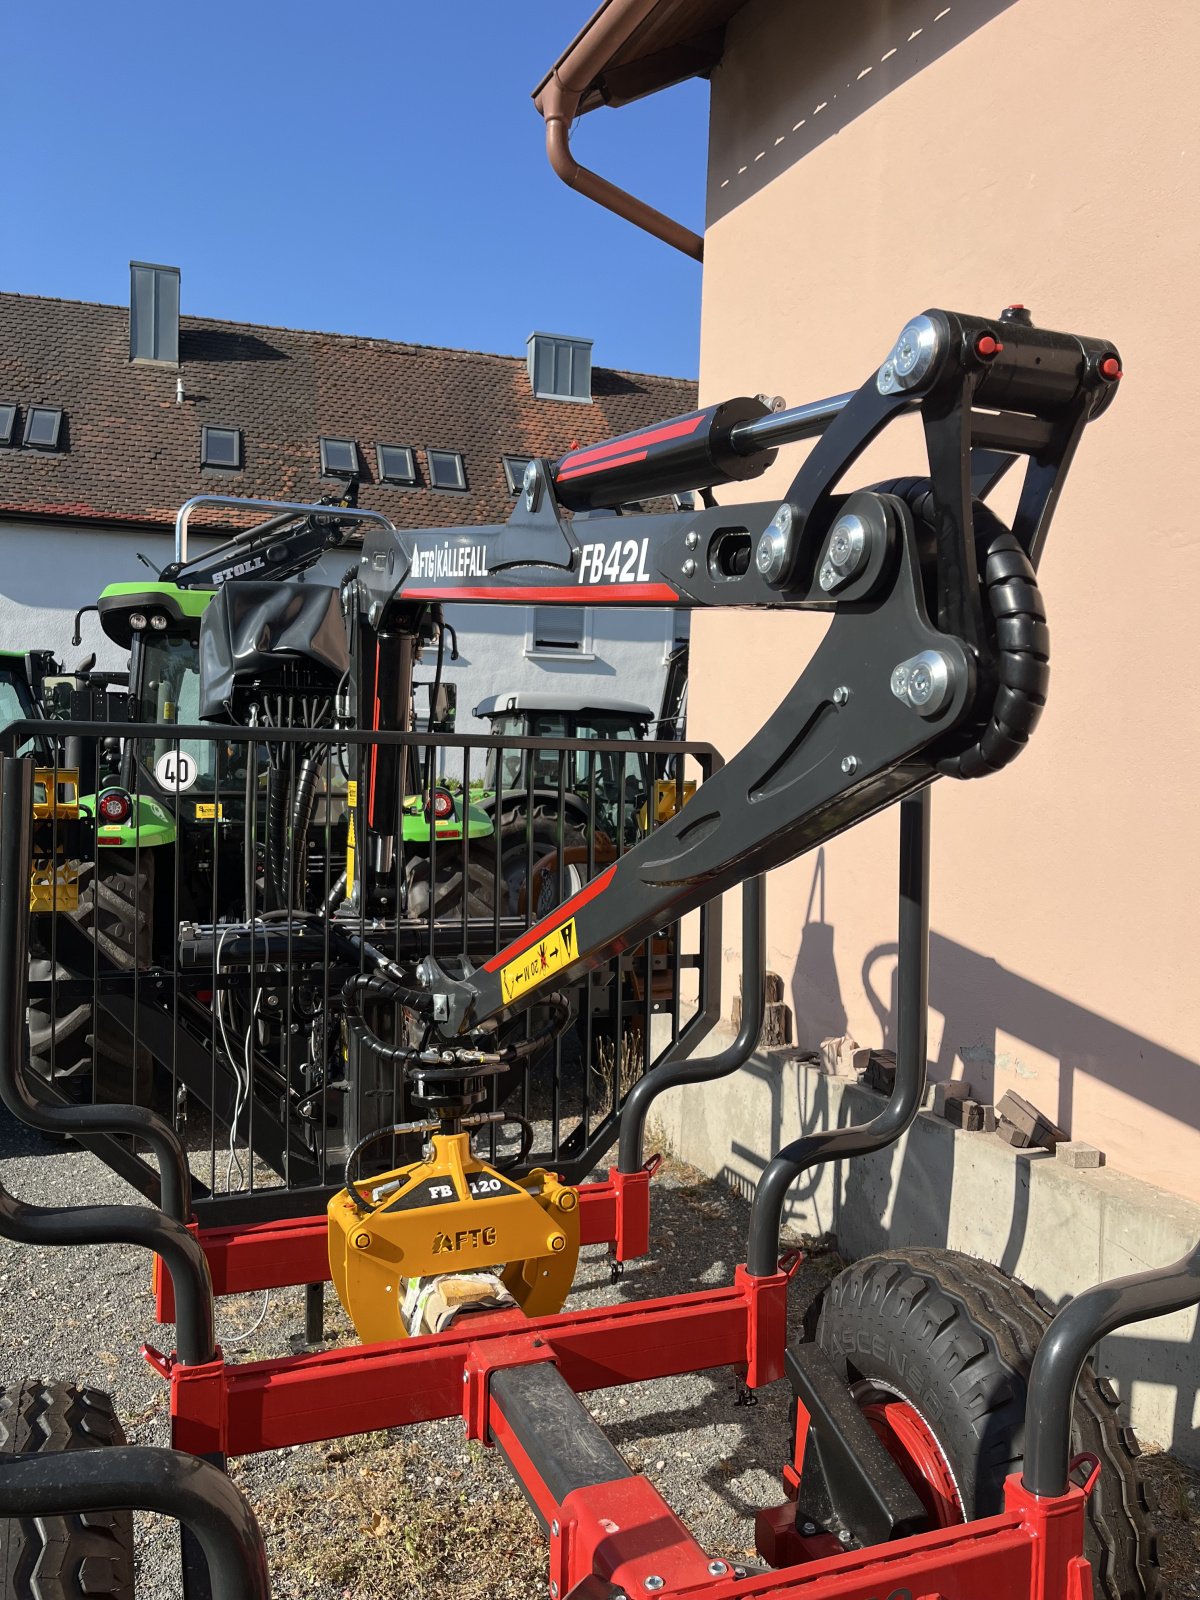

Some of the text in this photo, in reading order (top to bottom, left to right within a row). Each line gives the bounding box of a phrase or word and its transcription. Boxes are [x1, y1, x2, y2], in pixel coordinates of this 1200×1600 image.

[211, 556, 266, 585] STOLL
[578, 537, 650, 584] FB42L
[164, 758, 189, 784] 40
[428, 1179, 502, 1199] FB 120
[830, 1329, 944, 1422] ASCENSO
